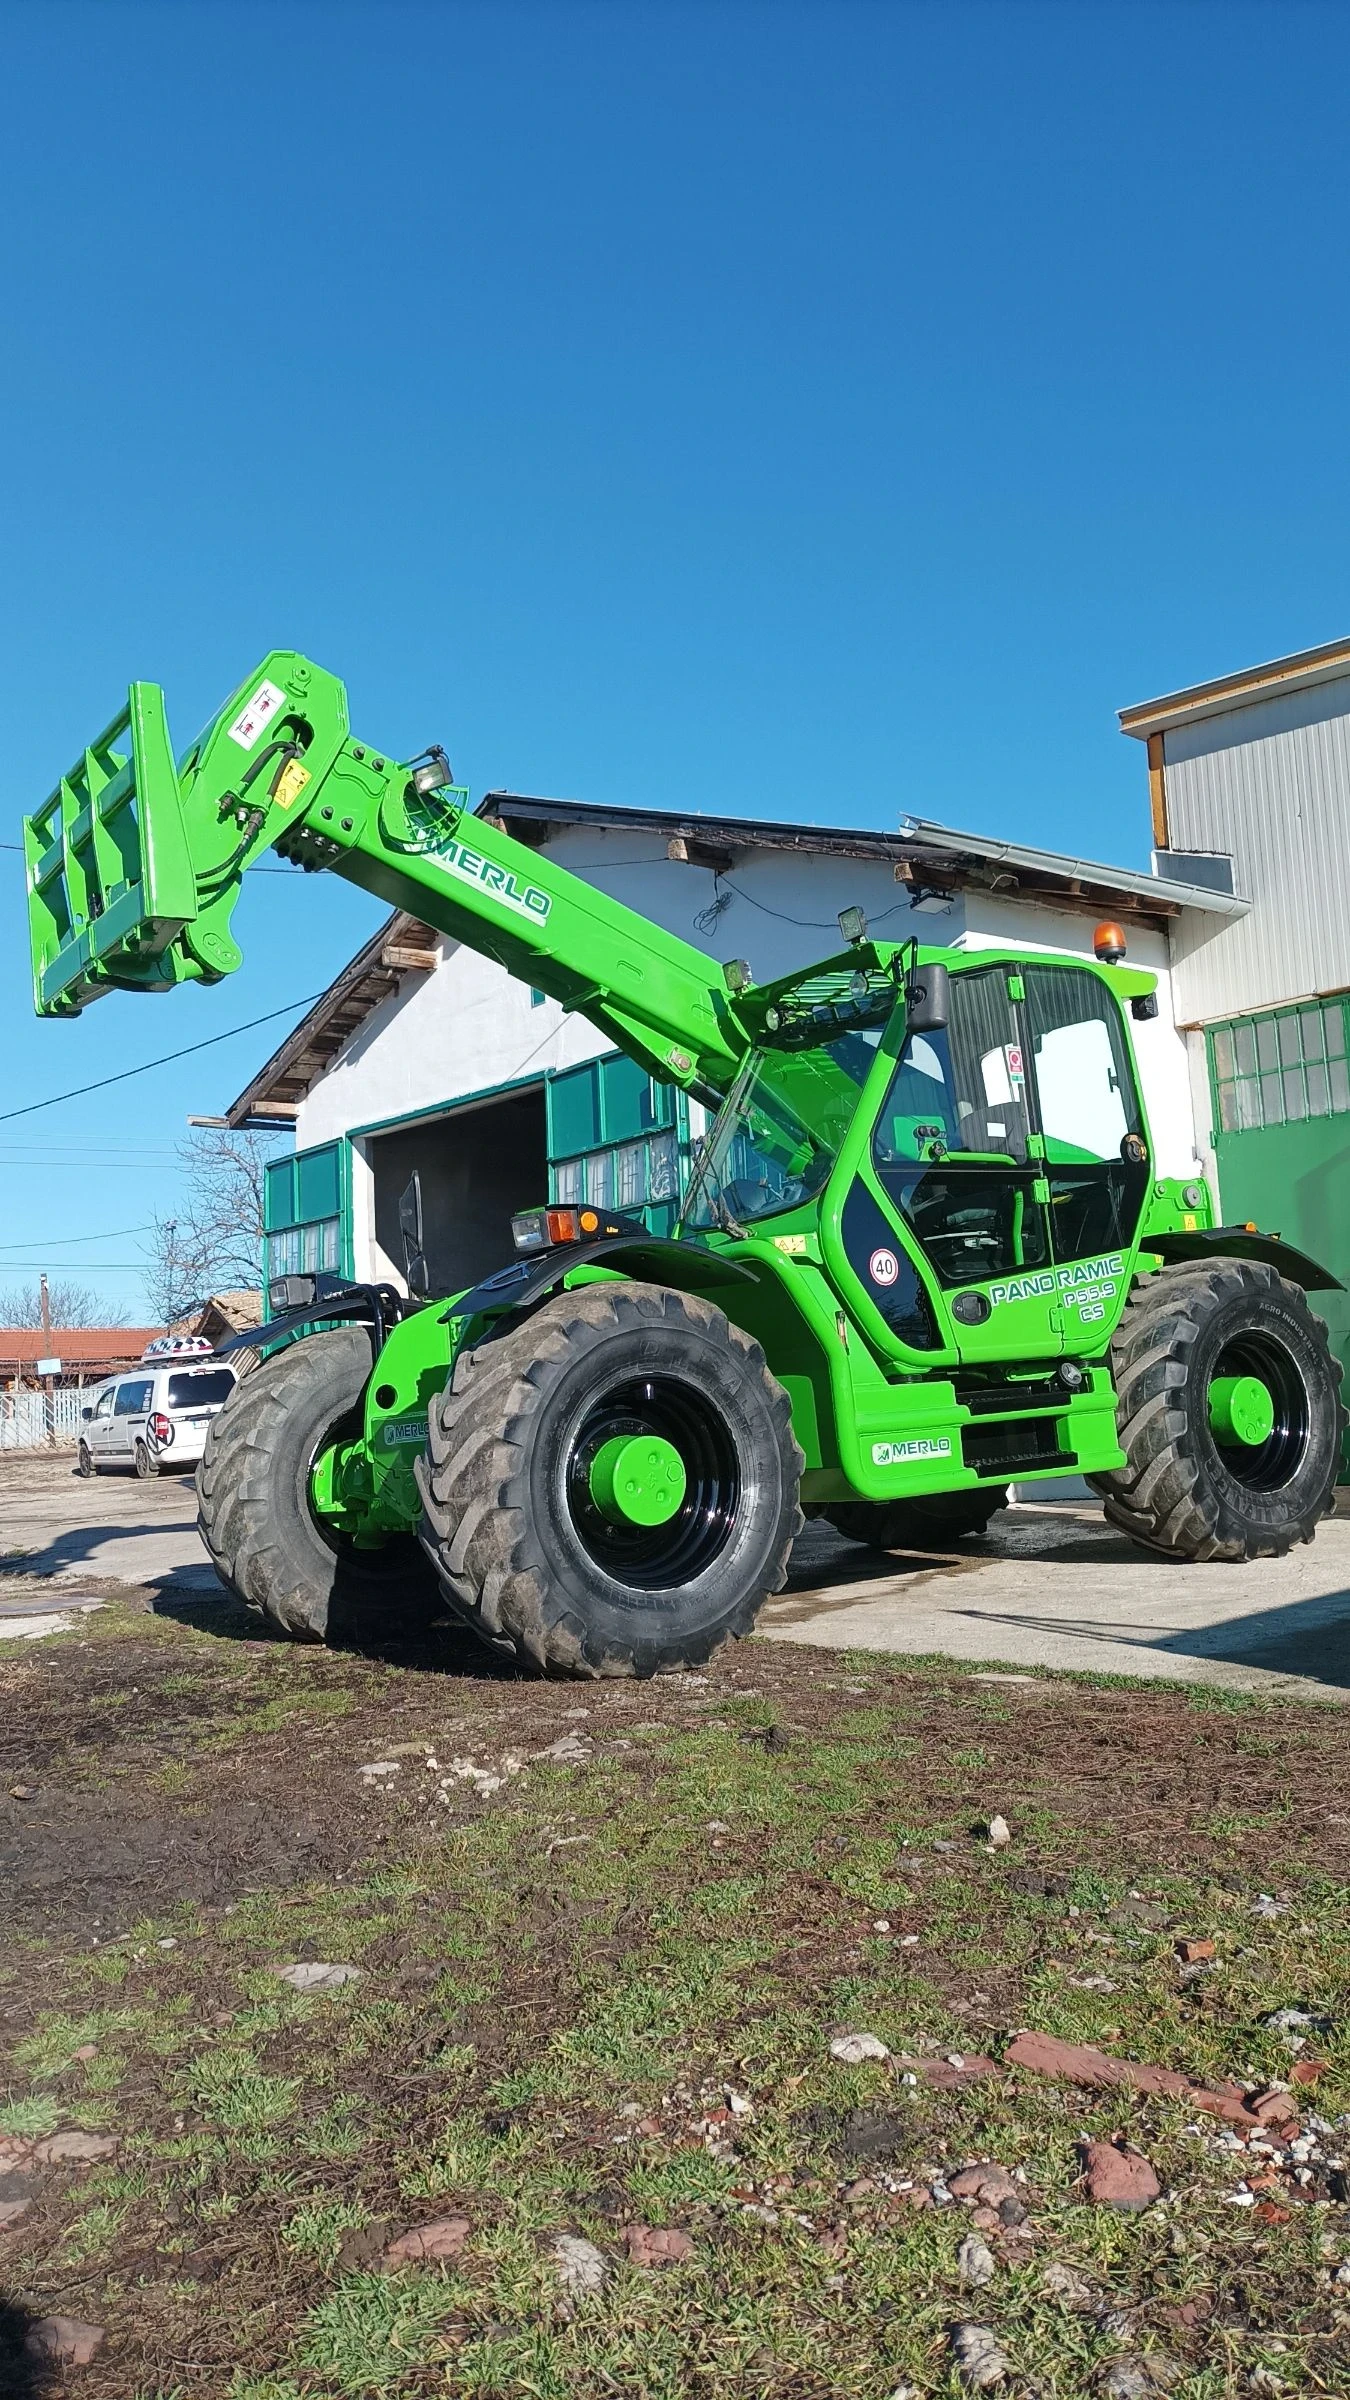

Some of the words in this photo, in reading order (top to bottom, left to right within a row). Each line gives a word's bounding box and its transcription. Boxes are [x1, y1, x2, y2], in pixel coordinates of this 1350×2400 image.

[426, 837, 550, 916] MERLO
[876, 1259, 892, 1275] 40
[990, 1256, 1123, 1304] PANORAMIC
[1065, 1283, 1115, 1306] P55.9
[1081, 1305, 1104, 1322] CS
[1259, 1302, 1281, 1315] AGRO
[892, 1438, 950, 1456] MERLO
